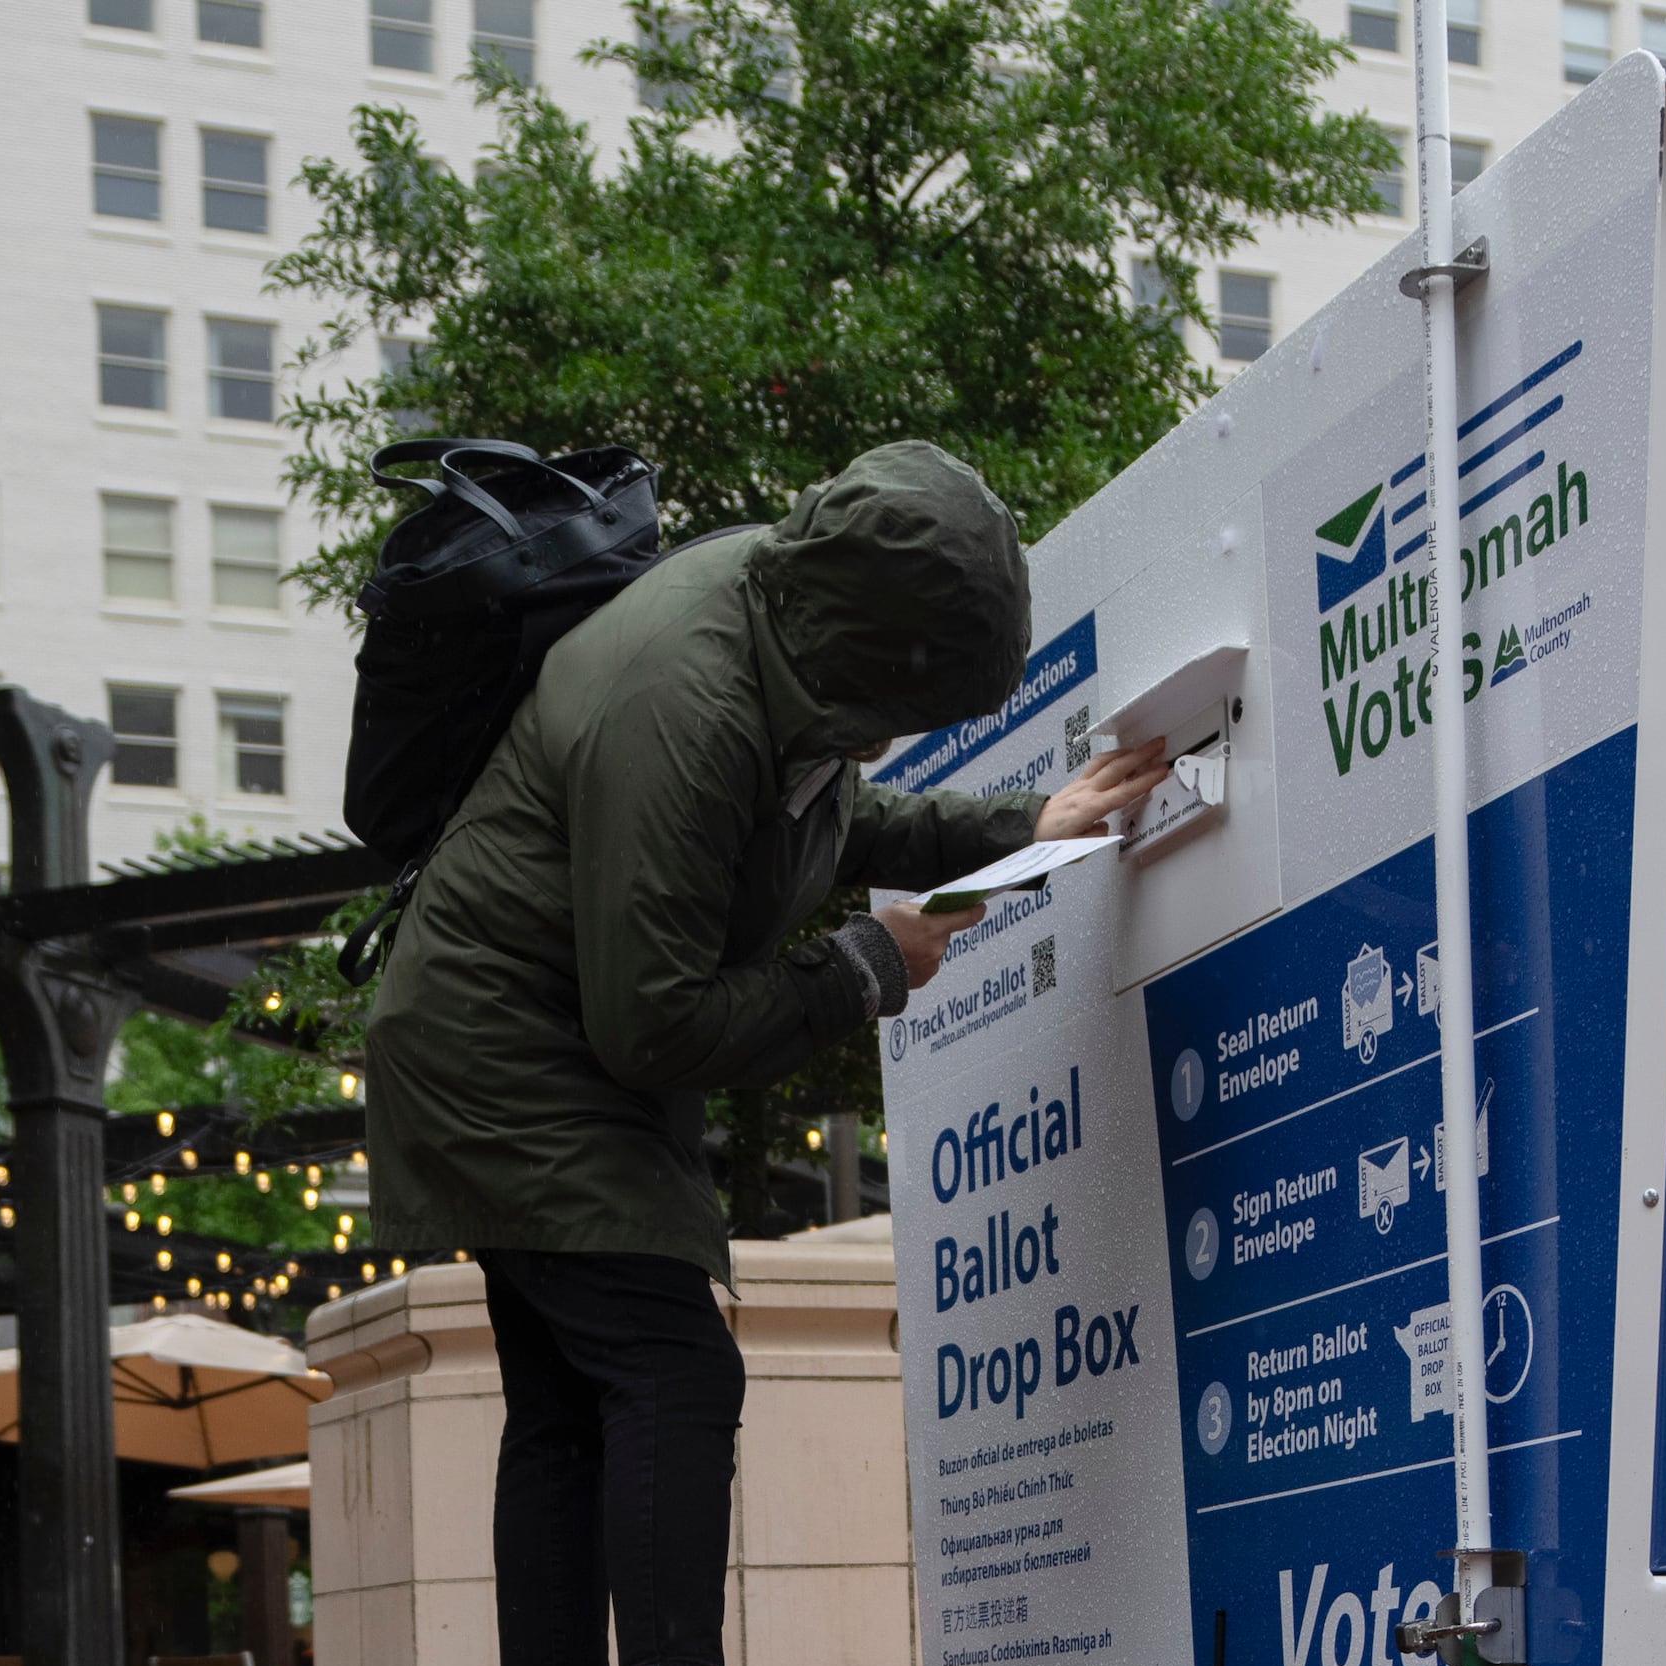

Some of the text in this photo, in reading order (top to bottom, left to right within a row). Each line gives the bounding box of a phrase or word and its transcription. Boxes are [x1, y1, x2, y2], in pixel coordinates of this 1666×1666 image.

[1428, 520, 1437, 561] PIPE
[1428, 568, 1439, 658] VALENCIA
[1524, 592, 1590, 645] Multnomah
[1530, 629, 1571, 664] County
[1011, 650, 1077, 714] Elections
[910, 962, 1026, 1045] Track Your Ballot
[930, 992, 1027, 1053] multco.us/trackyourballot
[1217, 996, 1318, 1063] Seal Return
[1181, 1061, 1192, 1105] 1
[1219, 1048, 1300, 1103] Envelope
[932, 1065, 1082, 1204] Official
[1436, 1137, 1444, 1183] BALLOT
[1233, 1165, 1337, 1228] Sign Return
[935, 1202, 1059, 1313] Ballot
[1195, 1220, 1210, 1265] 2
[1234, 1216, 1316, 1266] Envelope
[1496, 1293, 1507, 1307] 12
[1415, 1316, 1450, 1337] OFFICIAL
[1418, 1337, 1448, 1357] BALLOT
[937, 1304, 1140, 1420] Drop Box
[1247, 1322, 1368, 1382] Return Ballot
[1421, 1360, 1444, 1377] DROP
[1247, 1378, 1342, 1426] by 8pm on
[1425, 1380, 1442, 1397] BOX
[1207, 1395, 1222, 1440] 3
[1247, 1406, 1377, 1463] Election Night
[939, 1420, 1113, 1477] Buzón oficial de entrega de boletas
[1461, 1481, 1468, 1490] 17
[941, 1518, 1063, 1558] Официальная урна для
[941, 1541, 1091, 1587] избирательных бюллетеней
[991, 1639, 1050, 1662] Codobixinta
[1052, 1631, 1096, 1655] Rasmiga
[1098, 1628, 1112, 1647] ah
